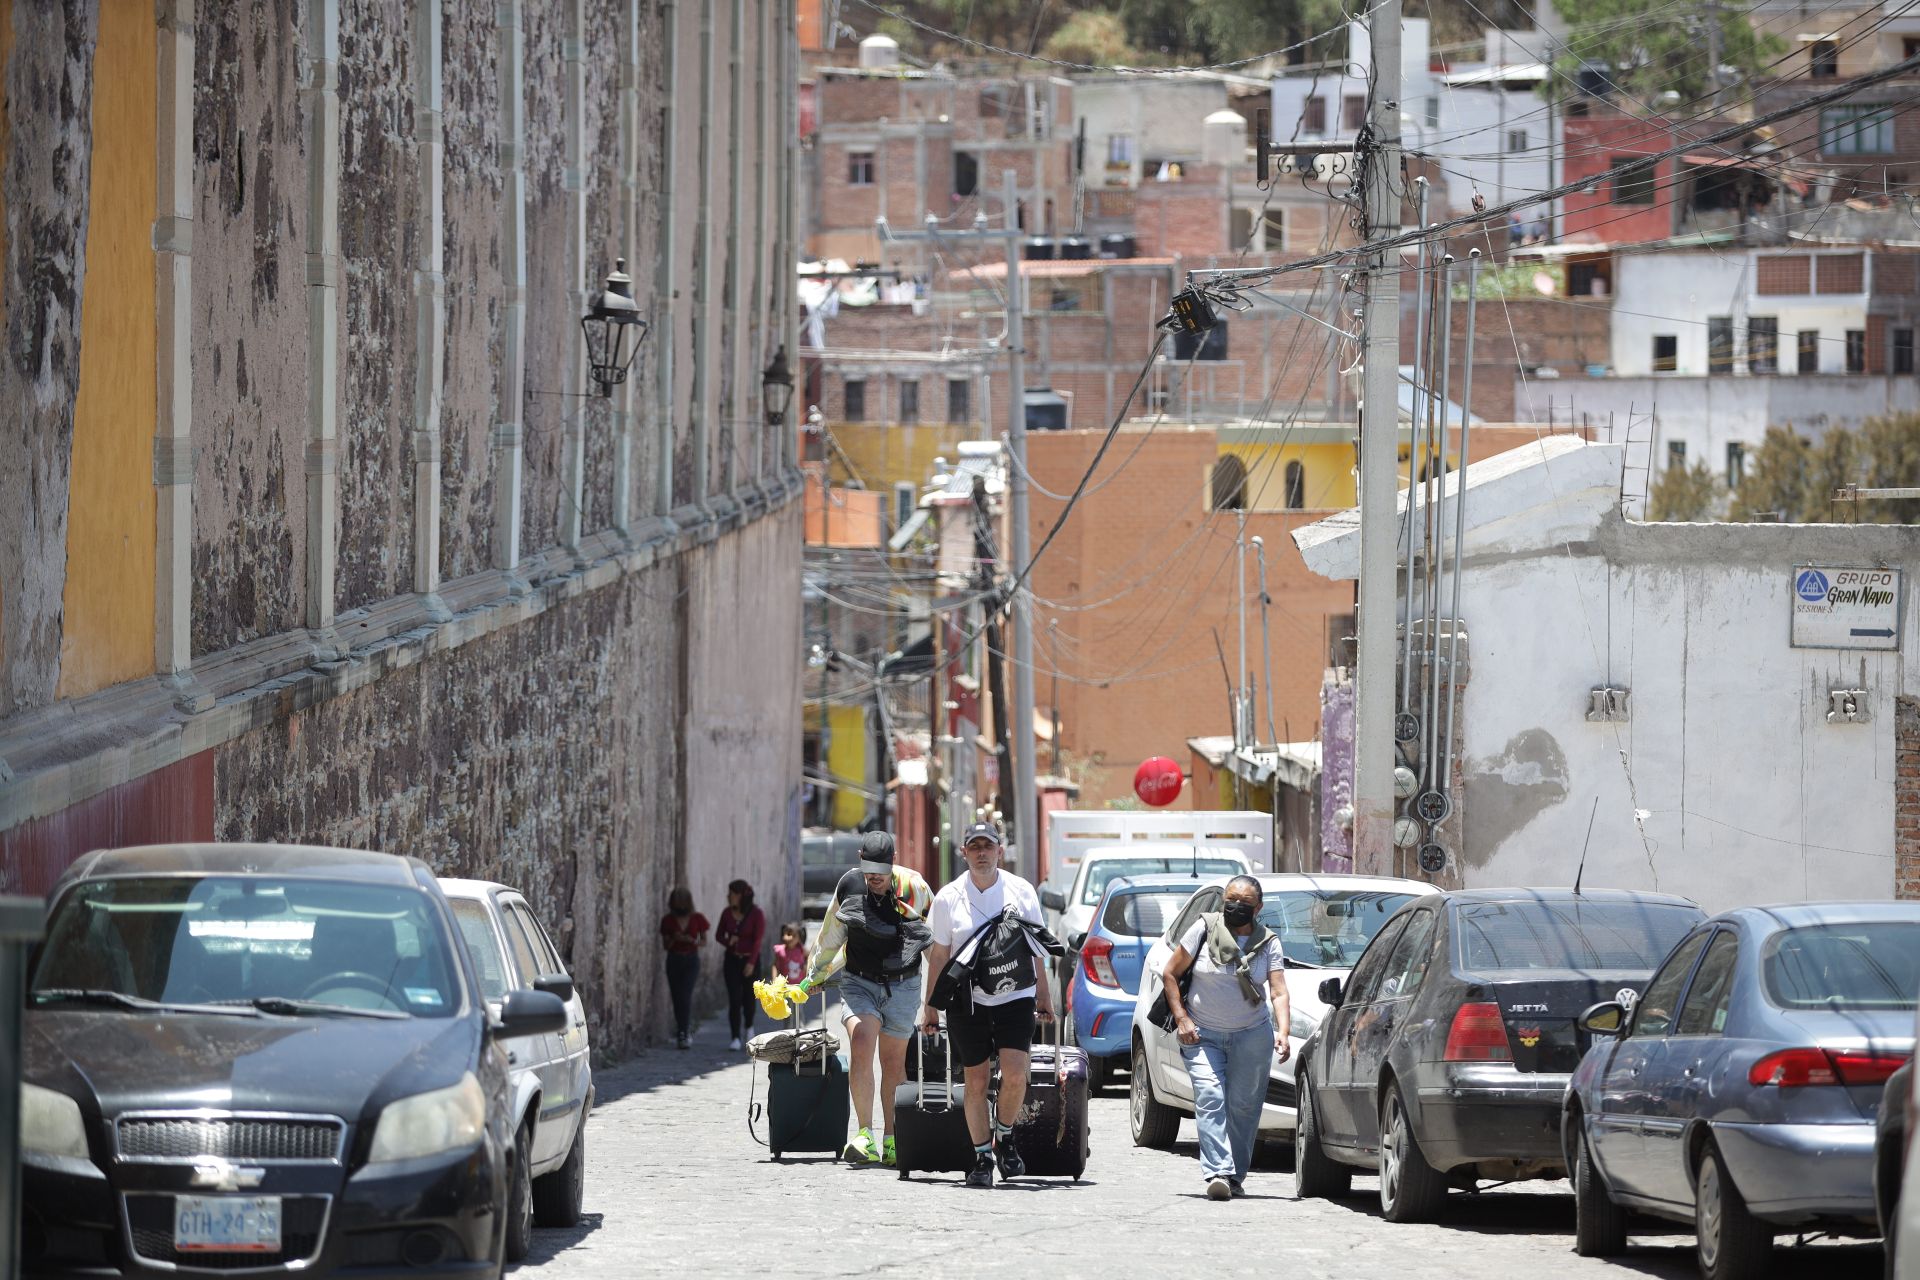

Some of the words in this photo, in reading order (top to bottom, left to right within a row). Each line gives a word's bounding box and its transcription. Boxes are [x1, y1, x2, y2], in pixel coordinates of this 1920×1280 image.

[1836, 572, 1892, 586] GRUPO
[1806, 582, 1819, 593] AA
[1827, 586, 1860, 607] GRAN
[1859, 586, 1894, 608] NAVIO
[1796, 604, 1833, 614] SESIONES
[988, 958, 1019, 976] JOAQUIN
[1508, 1003, 1549, 1013] JETTA
